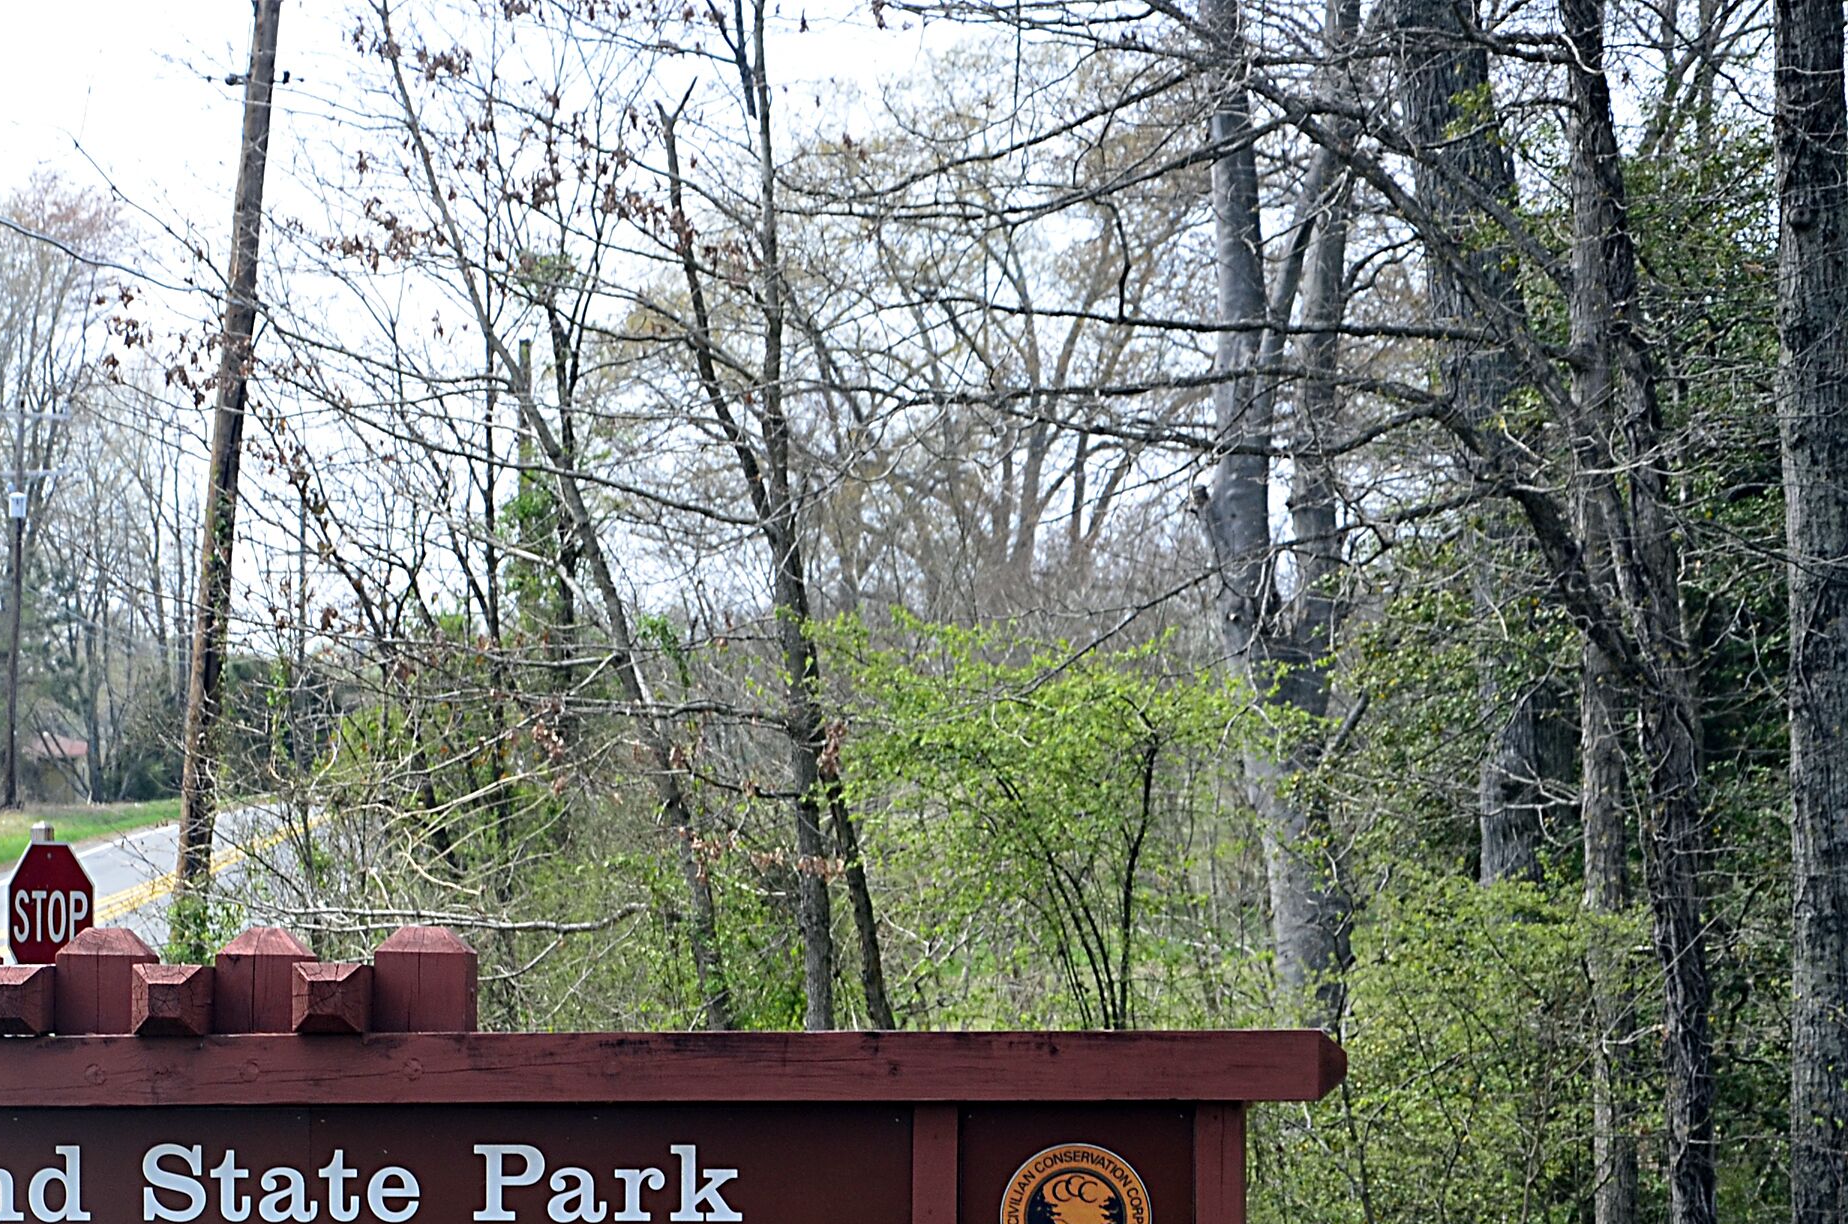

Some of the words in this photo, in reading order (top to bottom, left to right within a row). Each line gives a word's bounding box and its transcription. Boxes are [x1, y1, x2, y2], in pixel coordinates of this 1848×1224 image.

[13, 889, 89, 944] STOP
[141, 1143, 420, 1223] State
[472, 1143, 743, 1223] Park
[1034, 1150, 1132, 1188] CONSERVATION
[1052, 1175, 1098, 1203] CCC
